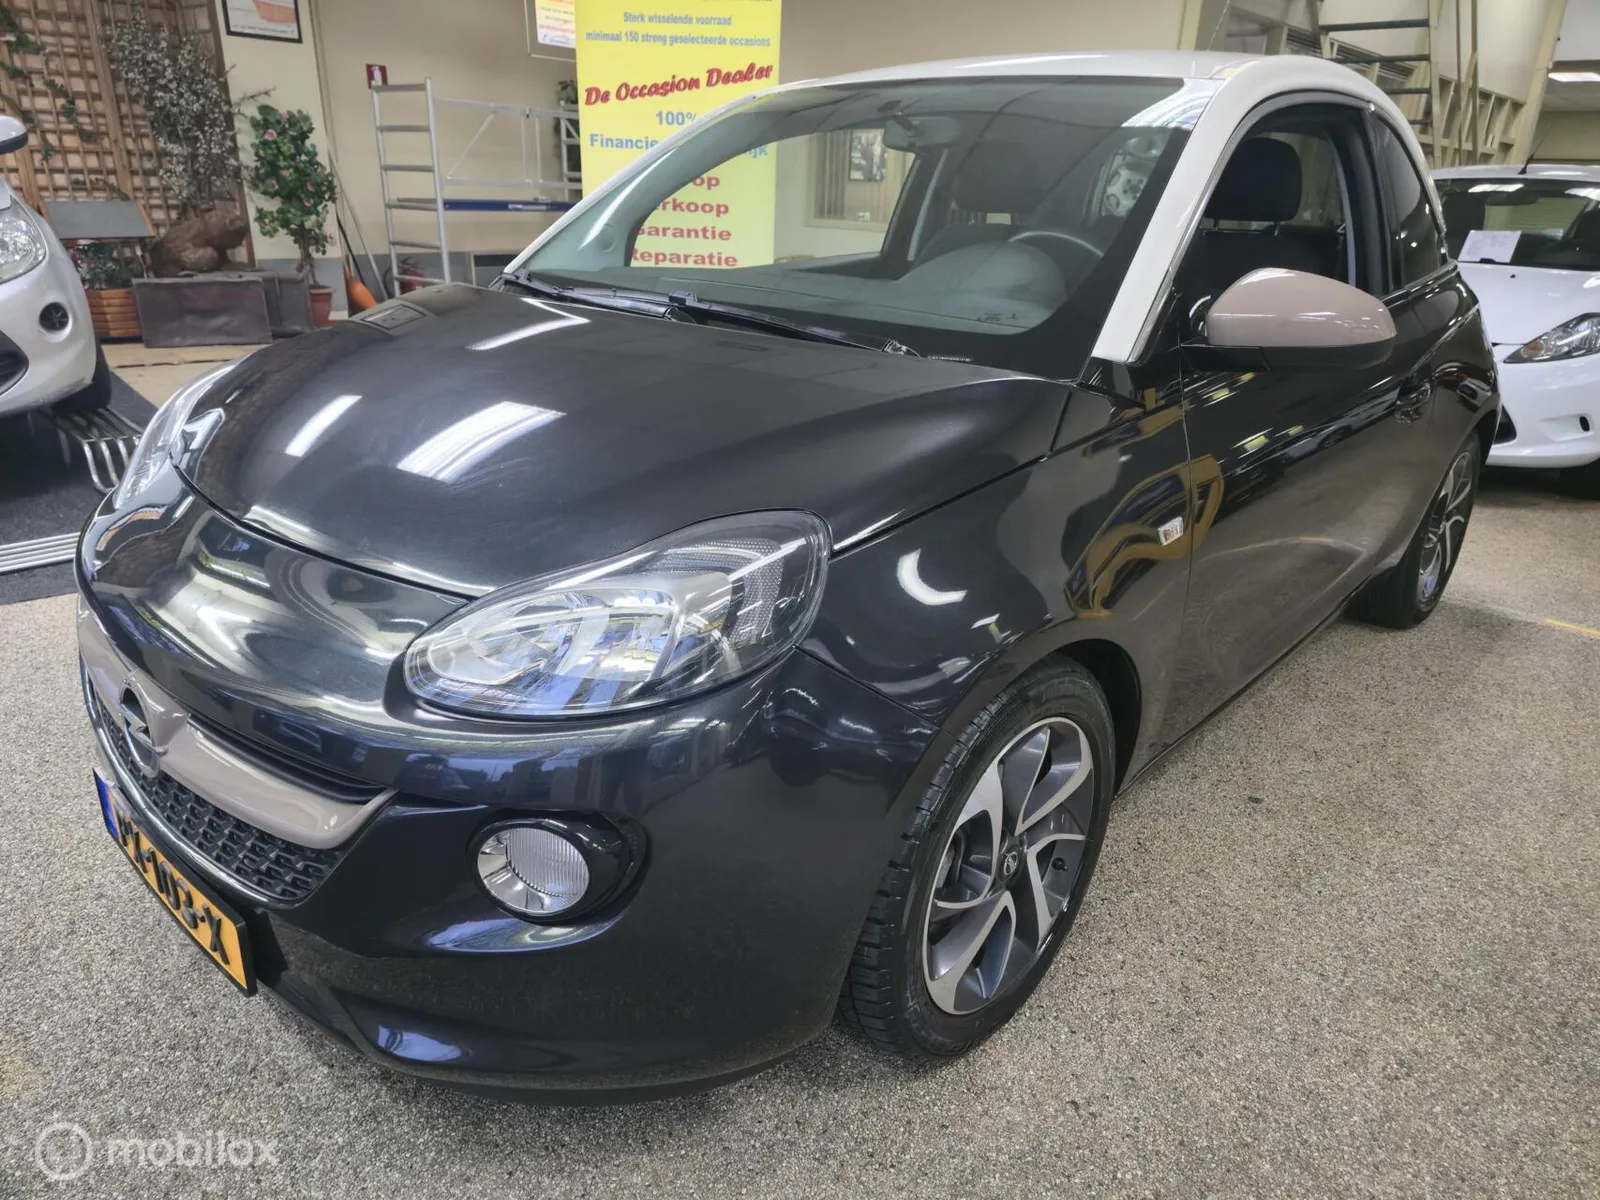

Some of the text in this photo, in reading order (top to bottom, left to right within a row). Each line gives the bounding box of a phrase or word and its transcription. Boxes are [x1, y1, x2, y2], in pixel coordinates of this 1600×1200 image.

[623, 11, 732, 26] Sterk wisselende voorraad
[585, 30, 622, 42] minimaal
[624, 31, 639, 42] 150
[669, 33, 727, 46] geselecteerde
[729, 36, 770, 47] occasions
[584, 62, 774, 106] De Occasion Dealer
[656, 197, 730, 218] rkoop
